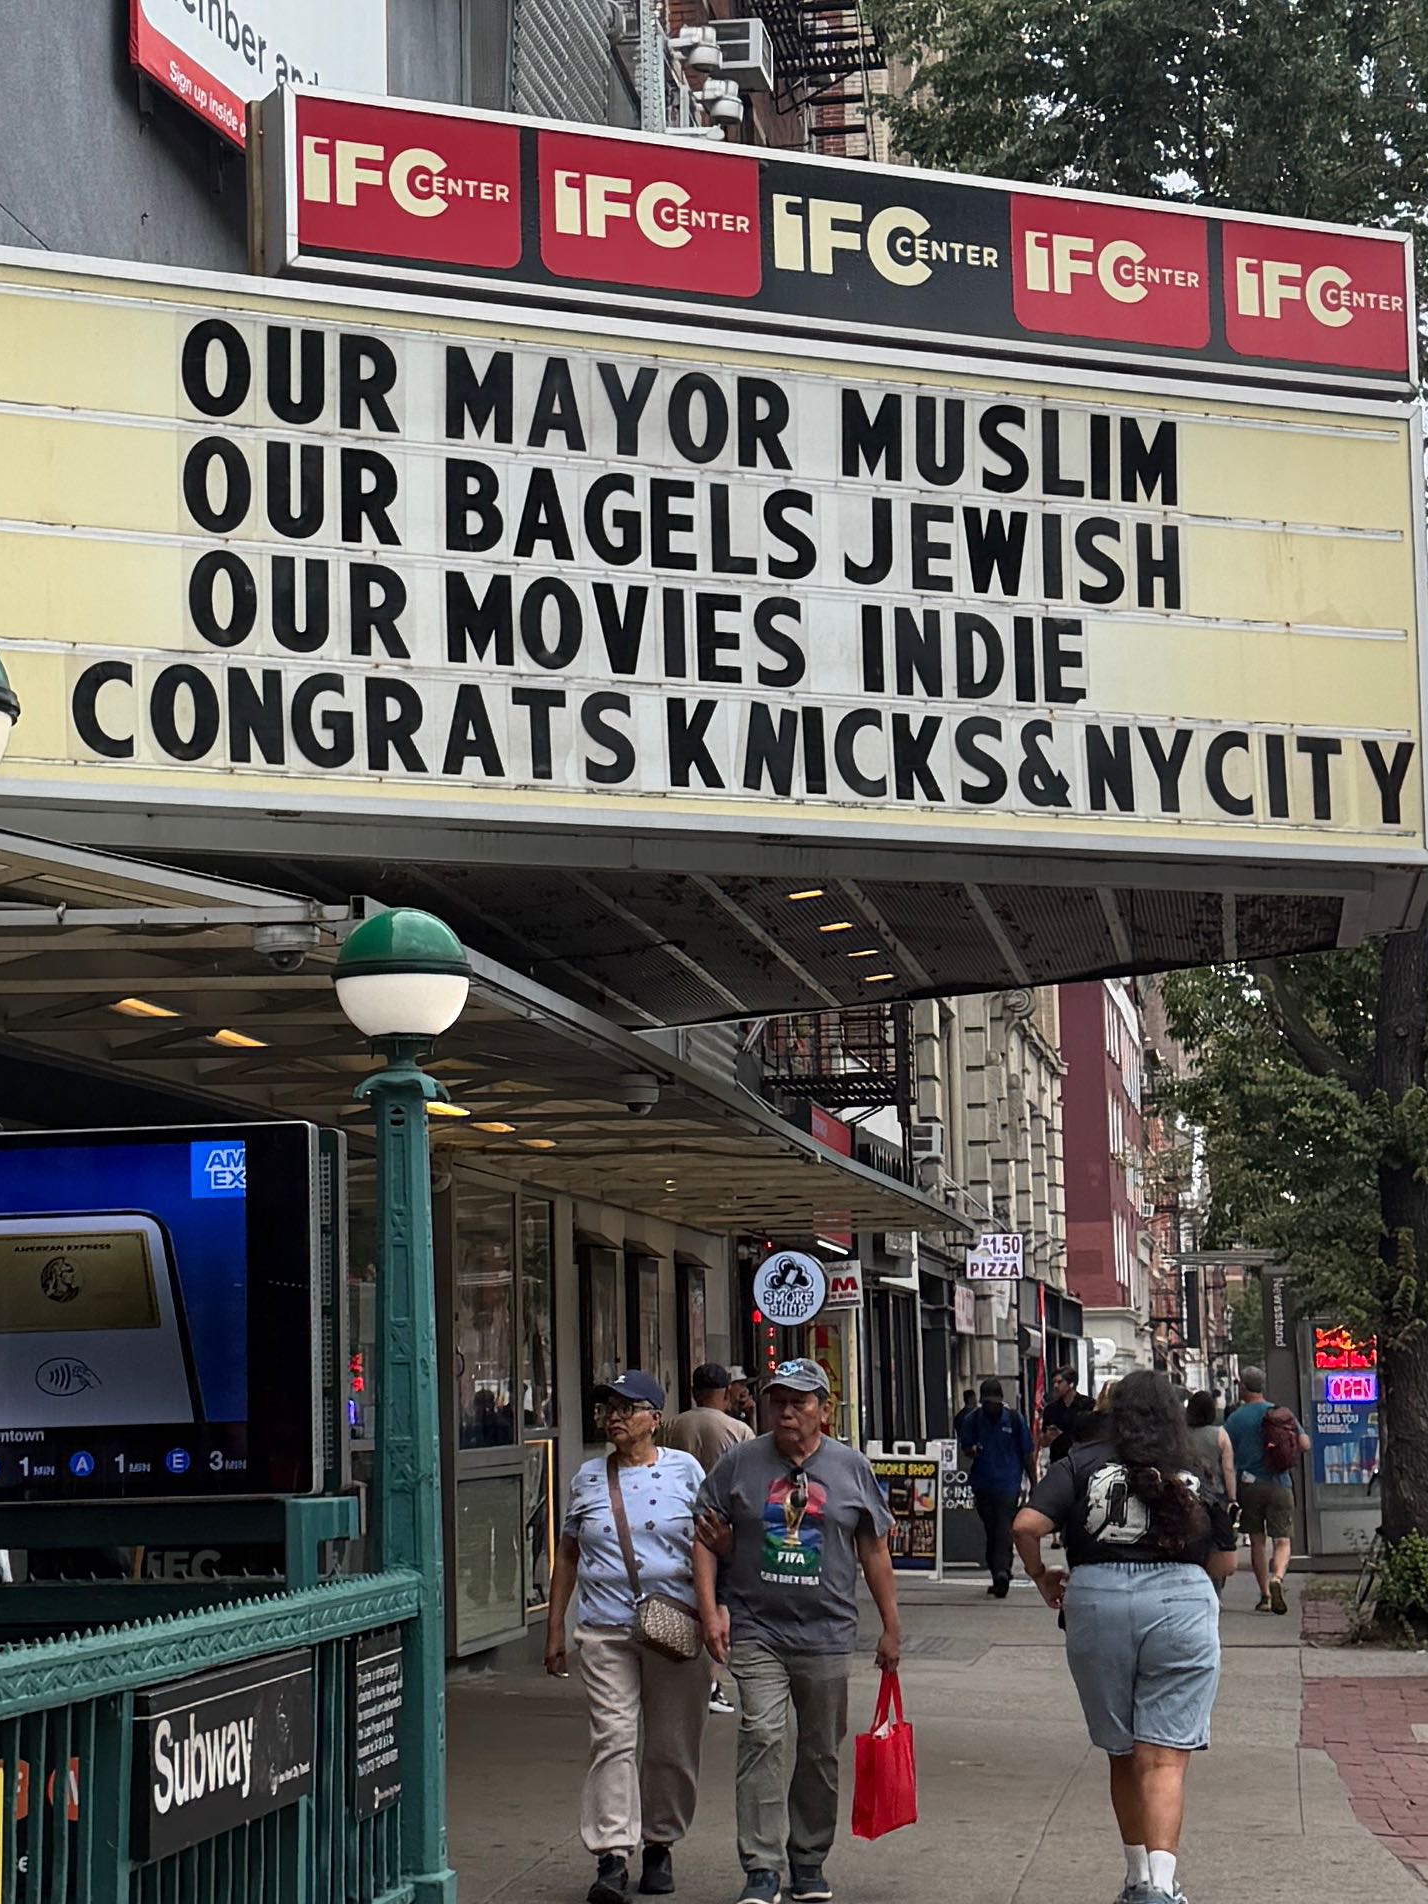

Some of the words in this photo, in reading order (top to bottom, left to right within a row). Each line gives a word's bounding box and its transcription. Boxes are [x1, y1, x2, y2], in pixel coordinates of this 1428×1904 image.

[276, 53, 320, 86] an
[169, 60, 192, 98] Sign
[193, 83, 208, 113] up
[207, 92, 238, 130] inside
[414, 172, 510, 204] CENTER
[660, 205, 750, 234] CENTER
[895, 236, 998, 268] CENTER
[1119, 261, 1200, 288] CENTER
[1326, 286, 1403, 313] CENTER
[181, 317, 401, 434] OUR
[445, 345, 793, 470] MAYOR
[842, 387, 1178, 507] MUSLIM
[182, 436, 402, 546] OUR
[445, 458, 817, 580] BAGELS
[843, 497, 1181, 611] JEWISH
[188, 549, 411, 660] OUR
[445, 571, 806, 688] MOVIES
[862, 603, 1087, 705] INDIE
[72, 660, 636, 785] CONGRATS
[970, 1263, 1020, 1277] PIZZA
[764, 1290, 814, 1307] SMOKE
[769, 1303, 808, 1318] SHOP
[1272, 1278, 1287, 1347] Newsstand
[1330, 1376, 1372, 1400] OPEN
[19, 1456, 29, 1477] 1
[114, 1453, 125, 1474] 1
[209, 1450, 224, 1471] 3
[908, 1463, 935, 1476] SHOP
[943, 1485, 975, 1499] K-INS
[777, 1550, 805, 1566] FIFA
[154, 1713, 254, 1815] Subway
